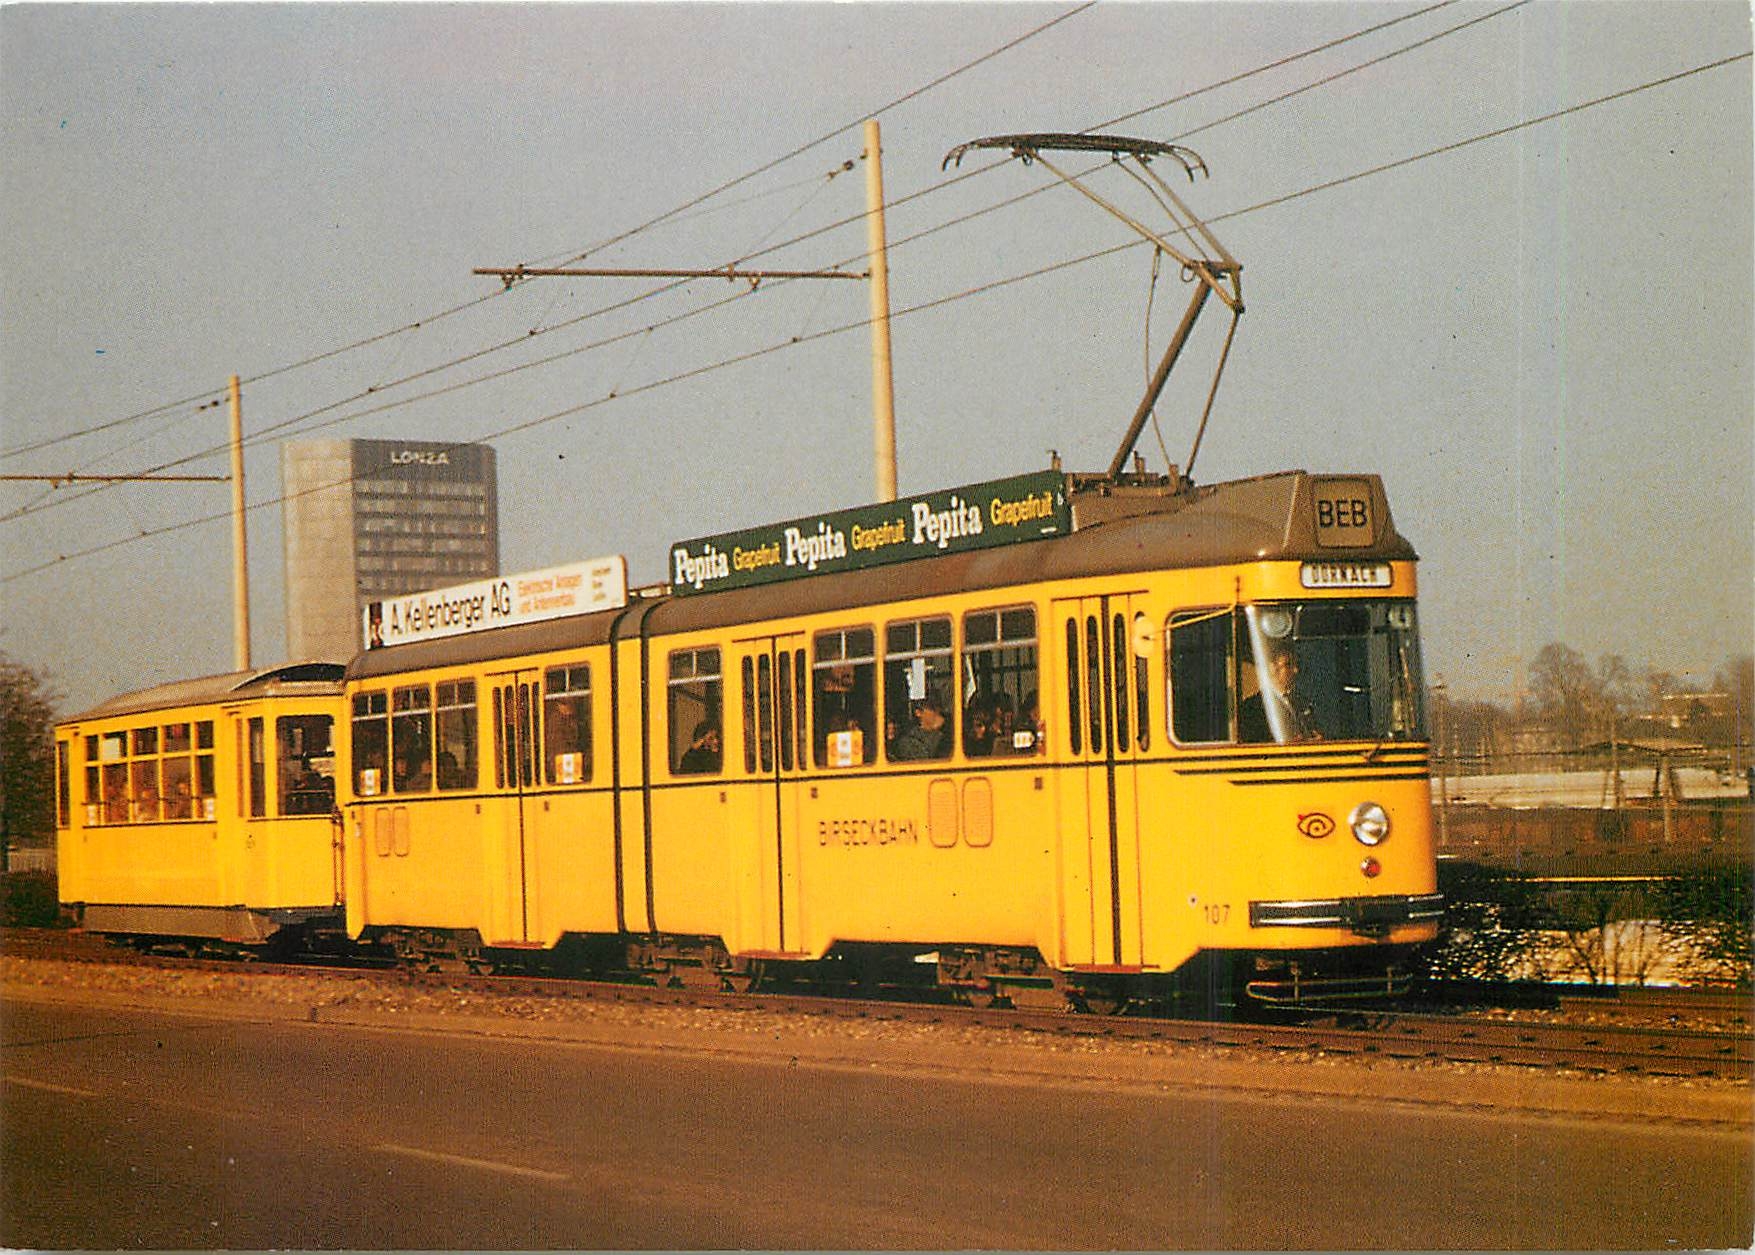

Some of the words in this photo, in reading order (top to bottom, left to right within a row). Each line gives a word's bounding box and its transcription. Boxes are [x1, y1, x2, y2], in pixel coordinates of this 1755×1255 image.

[391, 451, 449, 464] LONZA
[1318, 500, 1368, 528] BEB
[674, 544, 730, 589] Pepita
[733, 542, 780, 571] Grapefruit
[784, 521, 847, 571] Pepita
[851, 520, 904, 550] Grapefruit
[911, 496, 983, 549] Pepita
[990, 491, 1053, 527] Grapefruit
[405, 595, 485, 629] Kellenberger
[491, 581, 512, 618] AG
[819, 819, 918, 846] BIRSECKBAHN
[1204, 904, 1230, 925] 107
